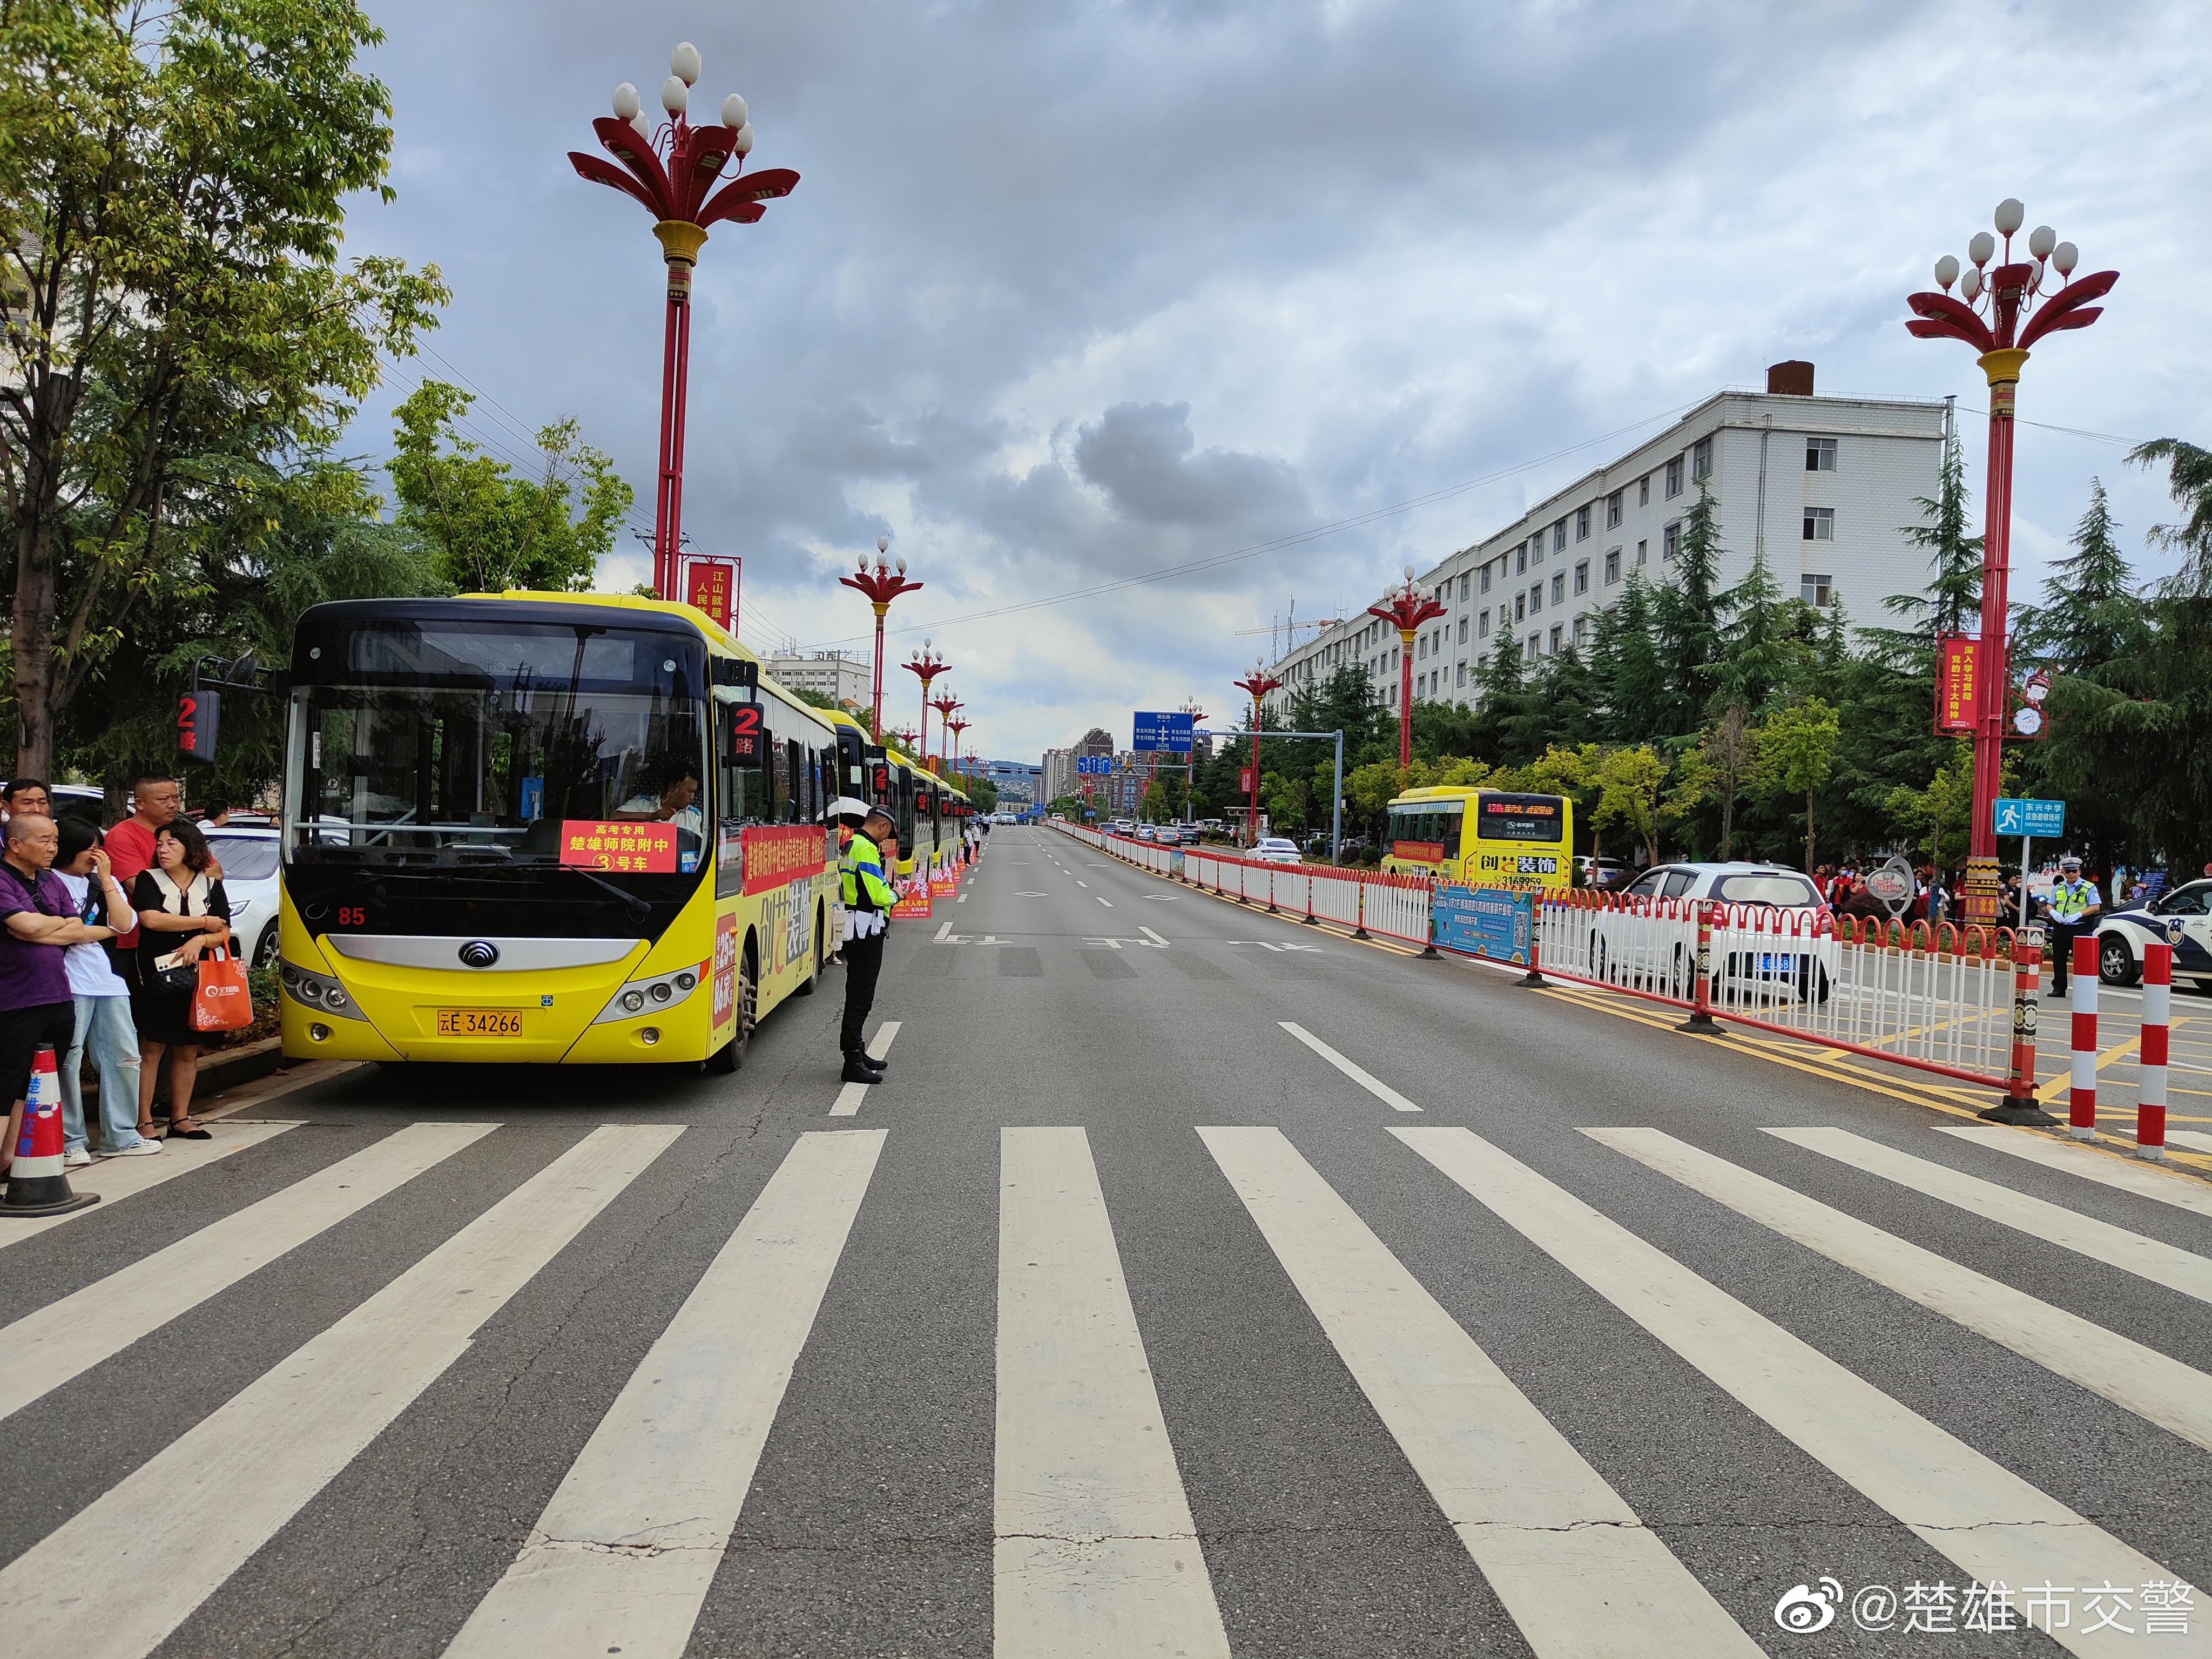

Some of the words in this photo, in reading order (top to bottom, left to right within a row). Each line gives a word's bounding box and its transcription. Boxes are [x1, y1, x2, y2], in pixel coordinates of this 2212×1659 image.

[711, 571, 724, 622] 江山就是
[1963, 646, 1974, 700] 深入学习贯彻
[1950, 655, 1961, 719] 党的二十大精神
[178, 698, 197, 727] 2
[735, 709, 758, 735] 2
[736, 738, 753, 754] 路
[875, 768, 887, 781] 2
[2026, 803, 2061, 812] 东兴中学
[2025, 812, 2060, 821] 应急避难场所
[596, 825, 644, 835] 高考专用
[570, 837, 668, 853] 楚雄师院附中
[1481, 855, 1556, 873] 创艺装饰
[932, 868, 943, 881] 08
[339, 907, 365, 925] 85
